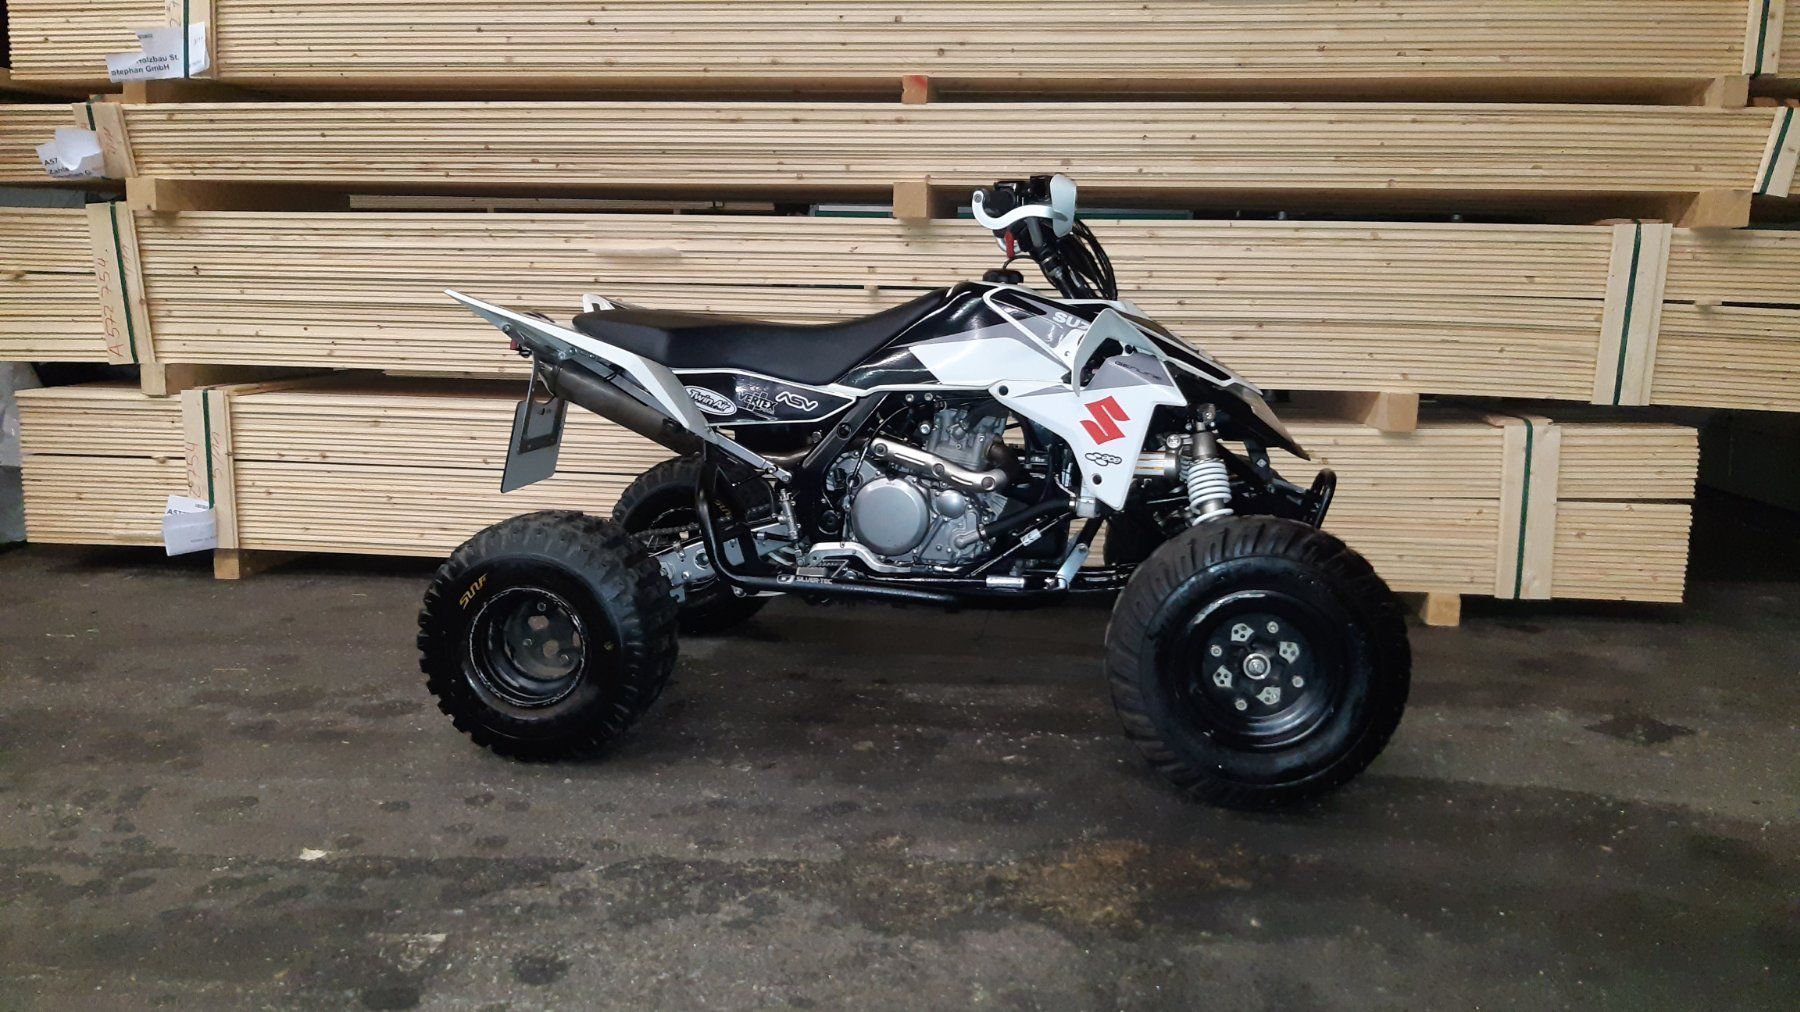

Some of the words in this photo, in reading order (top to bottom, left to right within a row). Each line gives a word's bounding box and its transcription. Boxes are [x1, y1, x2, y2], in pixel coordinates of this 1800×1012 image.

[145, 64, 170, 73] GmbH
[1052, 311, 1090, 330] SUZ
[690, 388, 714, 406] Twin
[712, 400, 731, 412] Air
[738, 391, 778, 410] VERTEX
